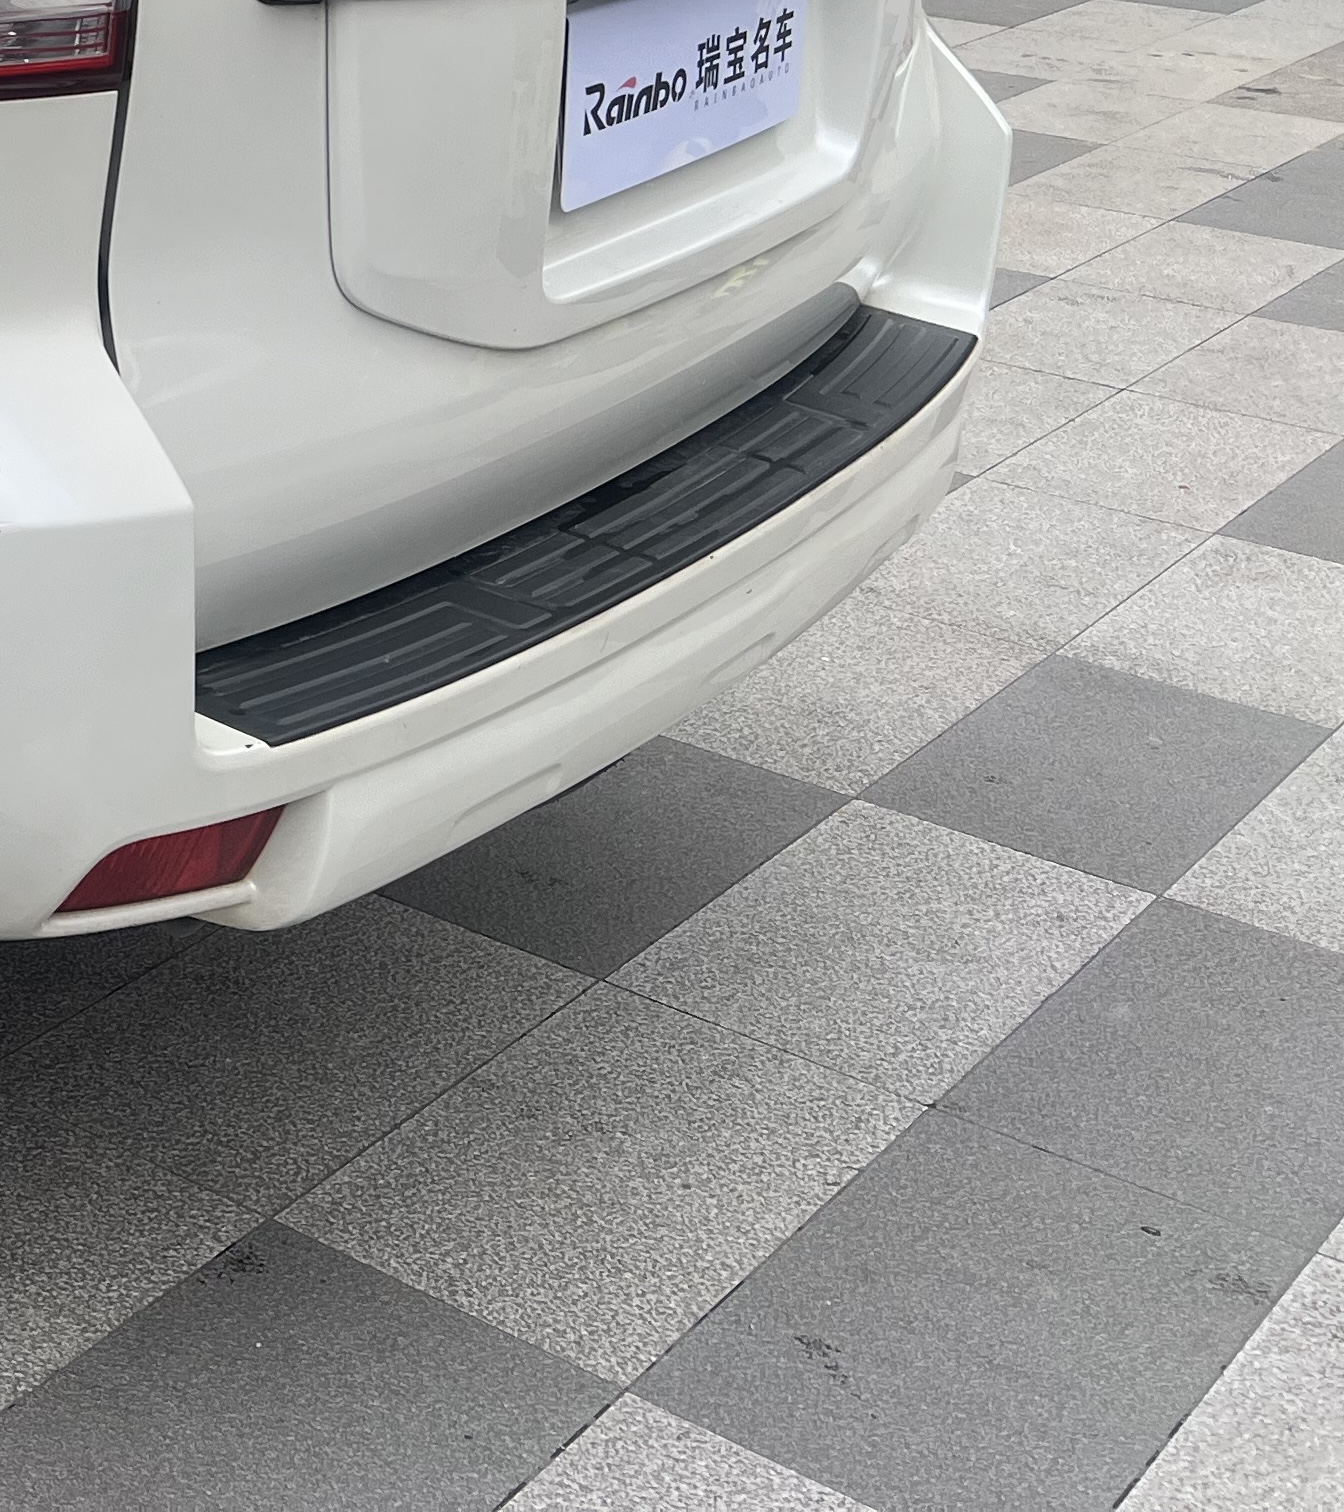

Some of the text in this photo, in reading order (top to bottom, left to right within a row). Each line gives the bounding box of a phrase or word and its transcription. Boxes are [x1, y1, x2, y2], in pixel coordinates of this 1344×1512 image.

[583, 7, 795, 137] Rainbo 瑞宝名车
